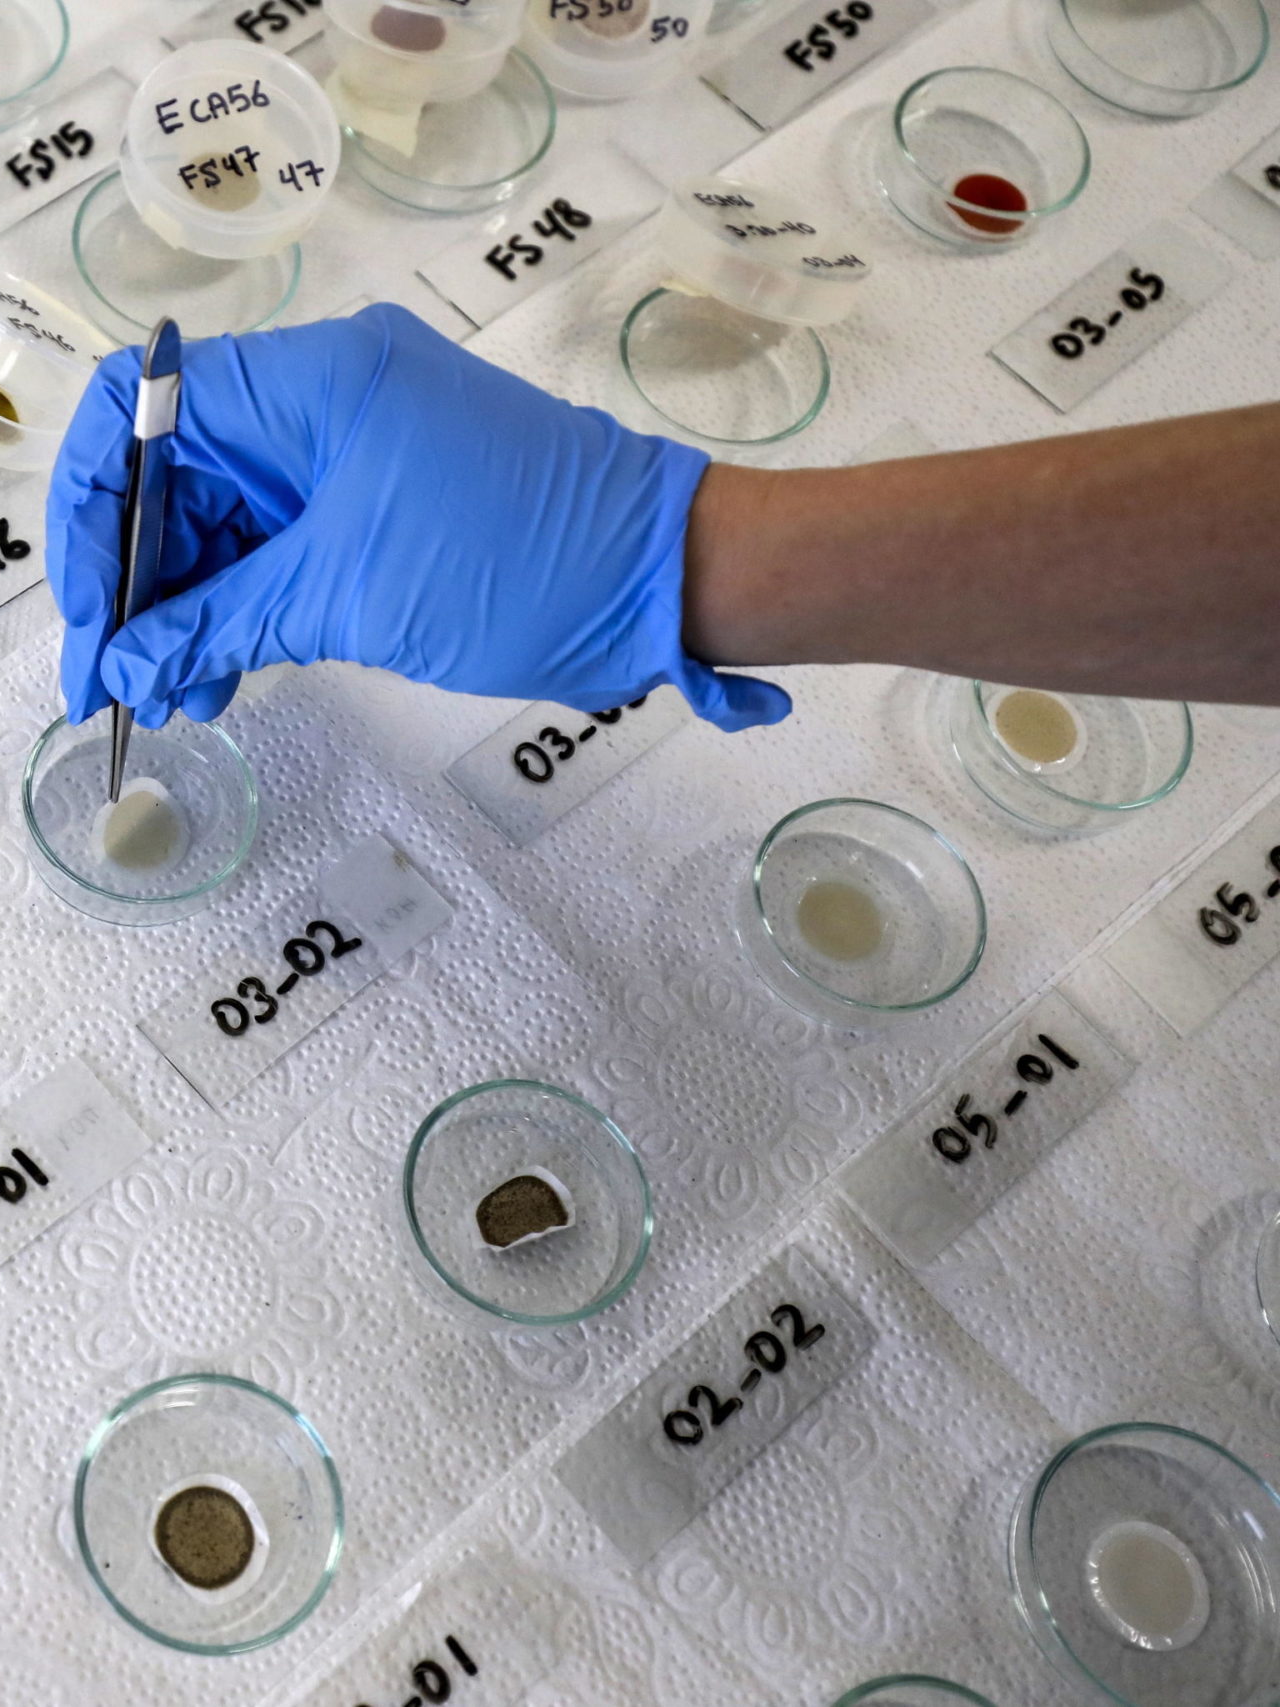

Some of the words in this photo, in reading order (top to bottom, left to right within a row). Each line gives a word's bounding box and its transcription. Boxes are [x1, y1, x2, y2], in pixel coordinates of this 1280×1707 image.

[234, 0, 323, 44] FS1
[651, 16, 689, 42] 50
[278, 159, 325, 192] 47
